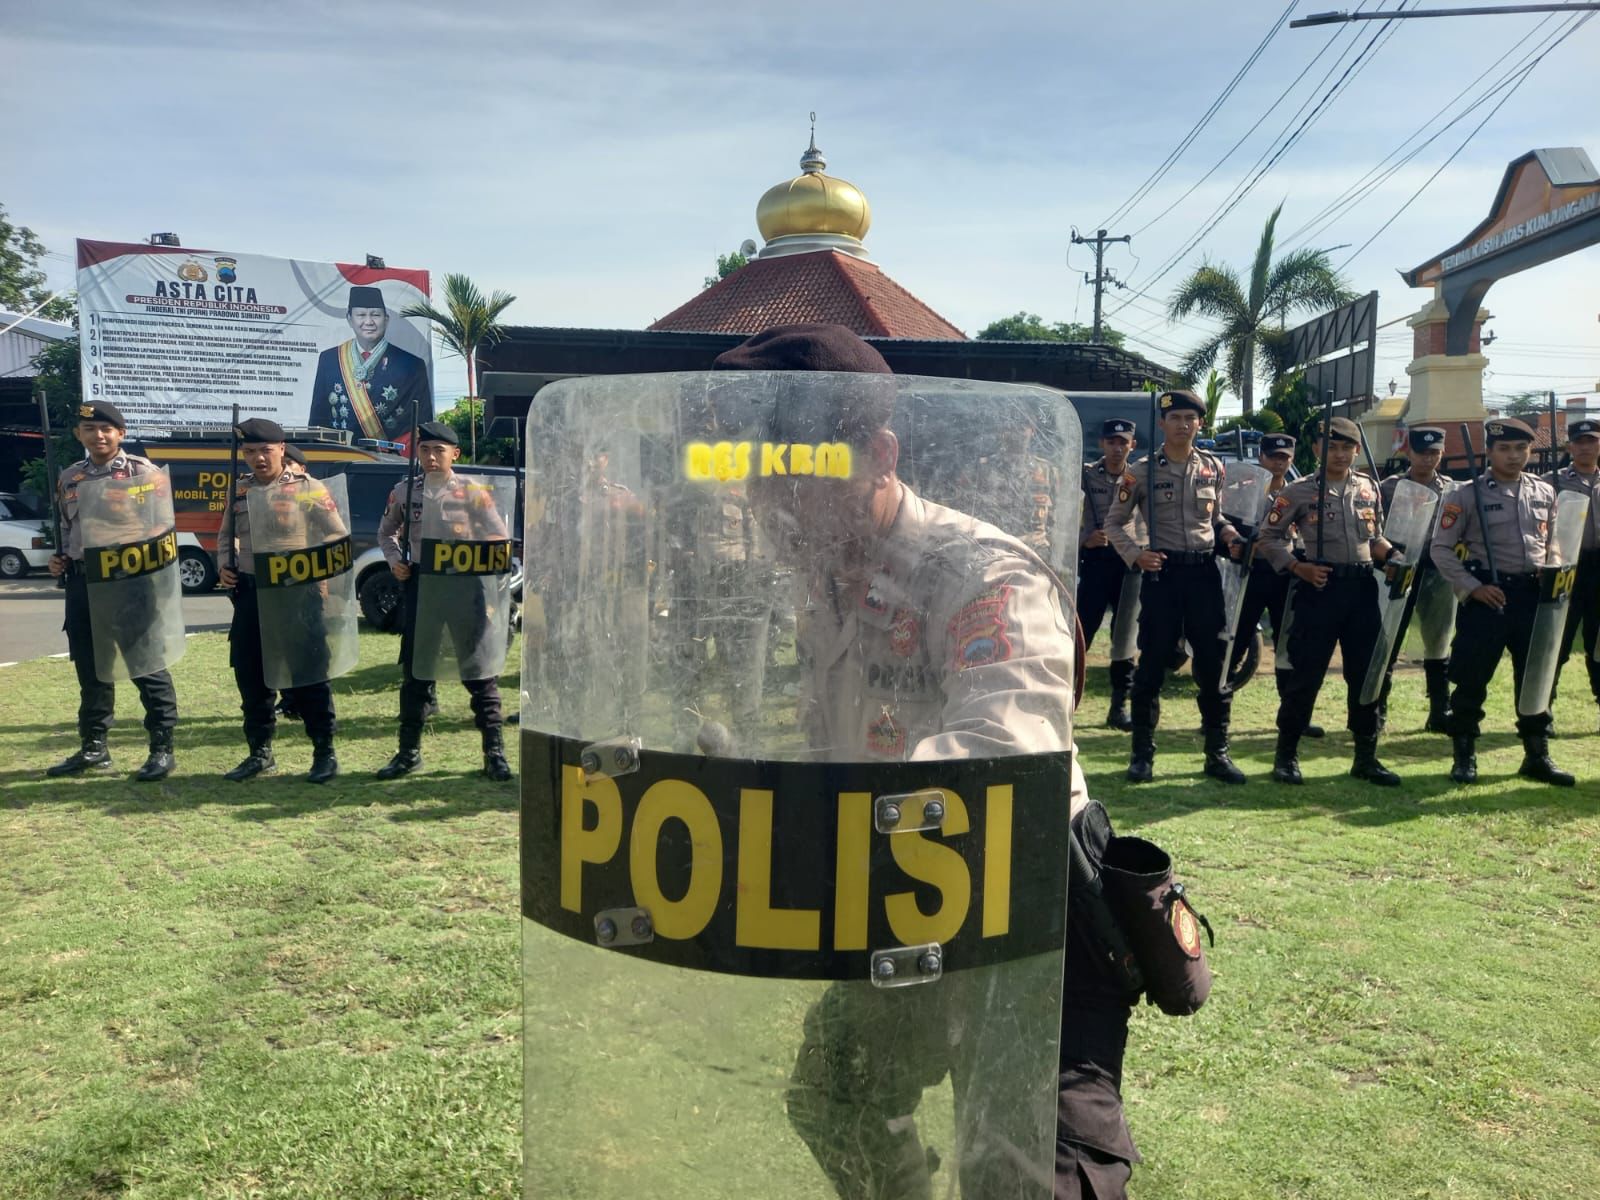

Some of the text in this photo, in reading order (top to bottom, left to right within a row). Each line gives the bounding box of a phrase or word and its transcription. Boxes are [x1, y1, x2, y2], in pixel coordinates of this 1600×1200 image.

[1440, 248, 1471, 271] TERIMA
[1471, 236, 1499, 259] KASIH
[1500, 223, 1525, 247] ATAS
[155, 280, 258, 304] ASTA CITA
[133, 296, 281, 314] PRESIDEN REPUBLIK INDONESIA
[89, 313, 95, 325] 1
[209, 310, 240, 319] PRABOWO
[90, 329, 96, 341] 2
[90, 345, 97, 357] 3
[92, 365, 98, 377] 4
[92, 383, 99, 395] 5
[761, 442, 851, 479] KBM
[175, 490, 209, 500] MOBIL
[100, 531, 177, 578] POLISI
[269, 543, 350, 584] POLISI
[433, 543, 511, 572] POLISI
[560, 764, 1014, 951] POLISI
